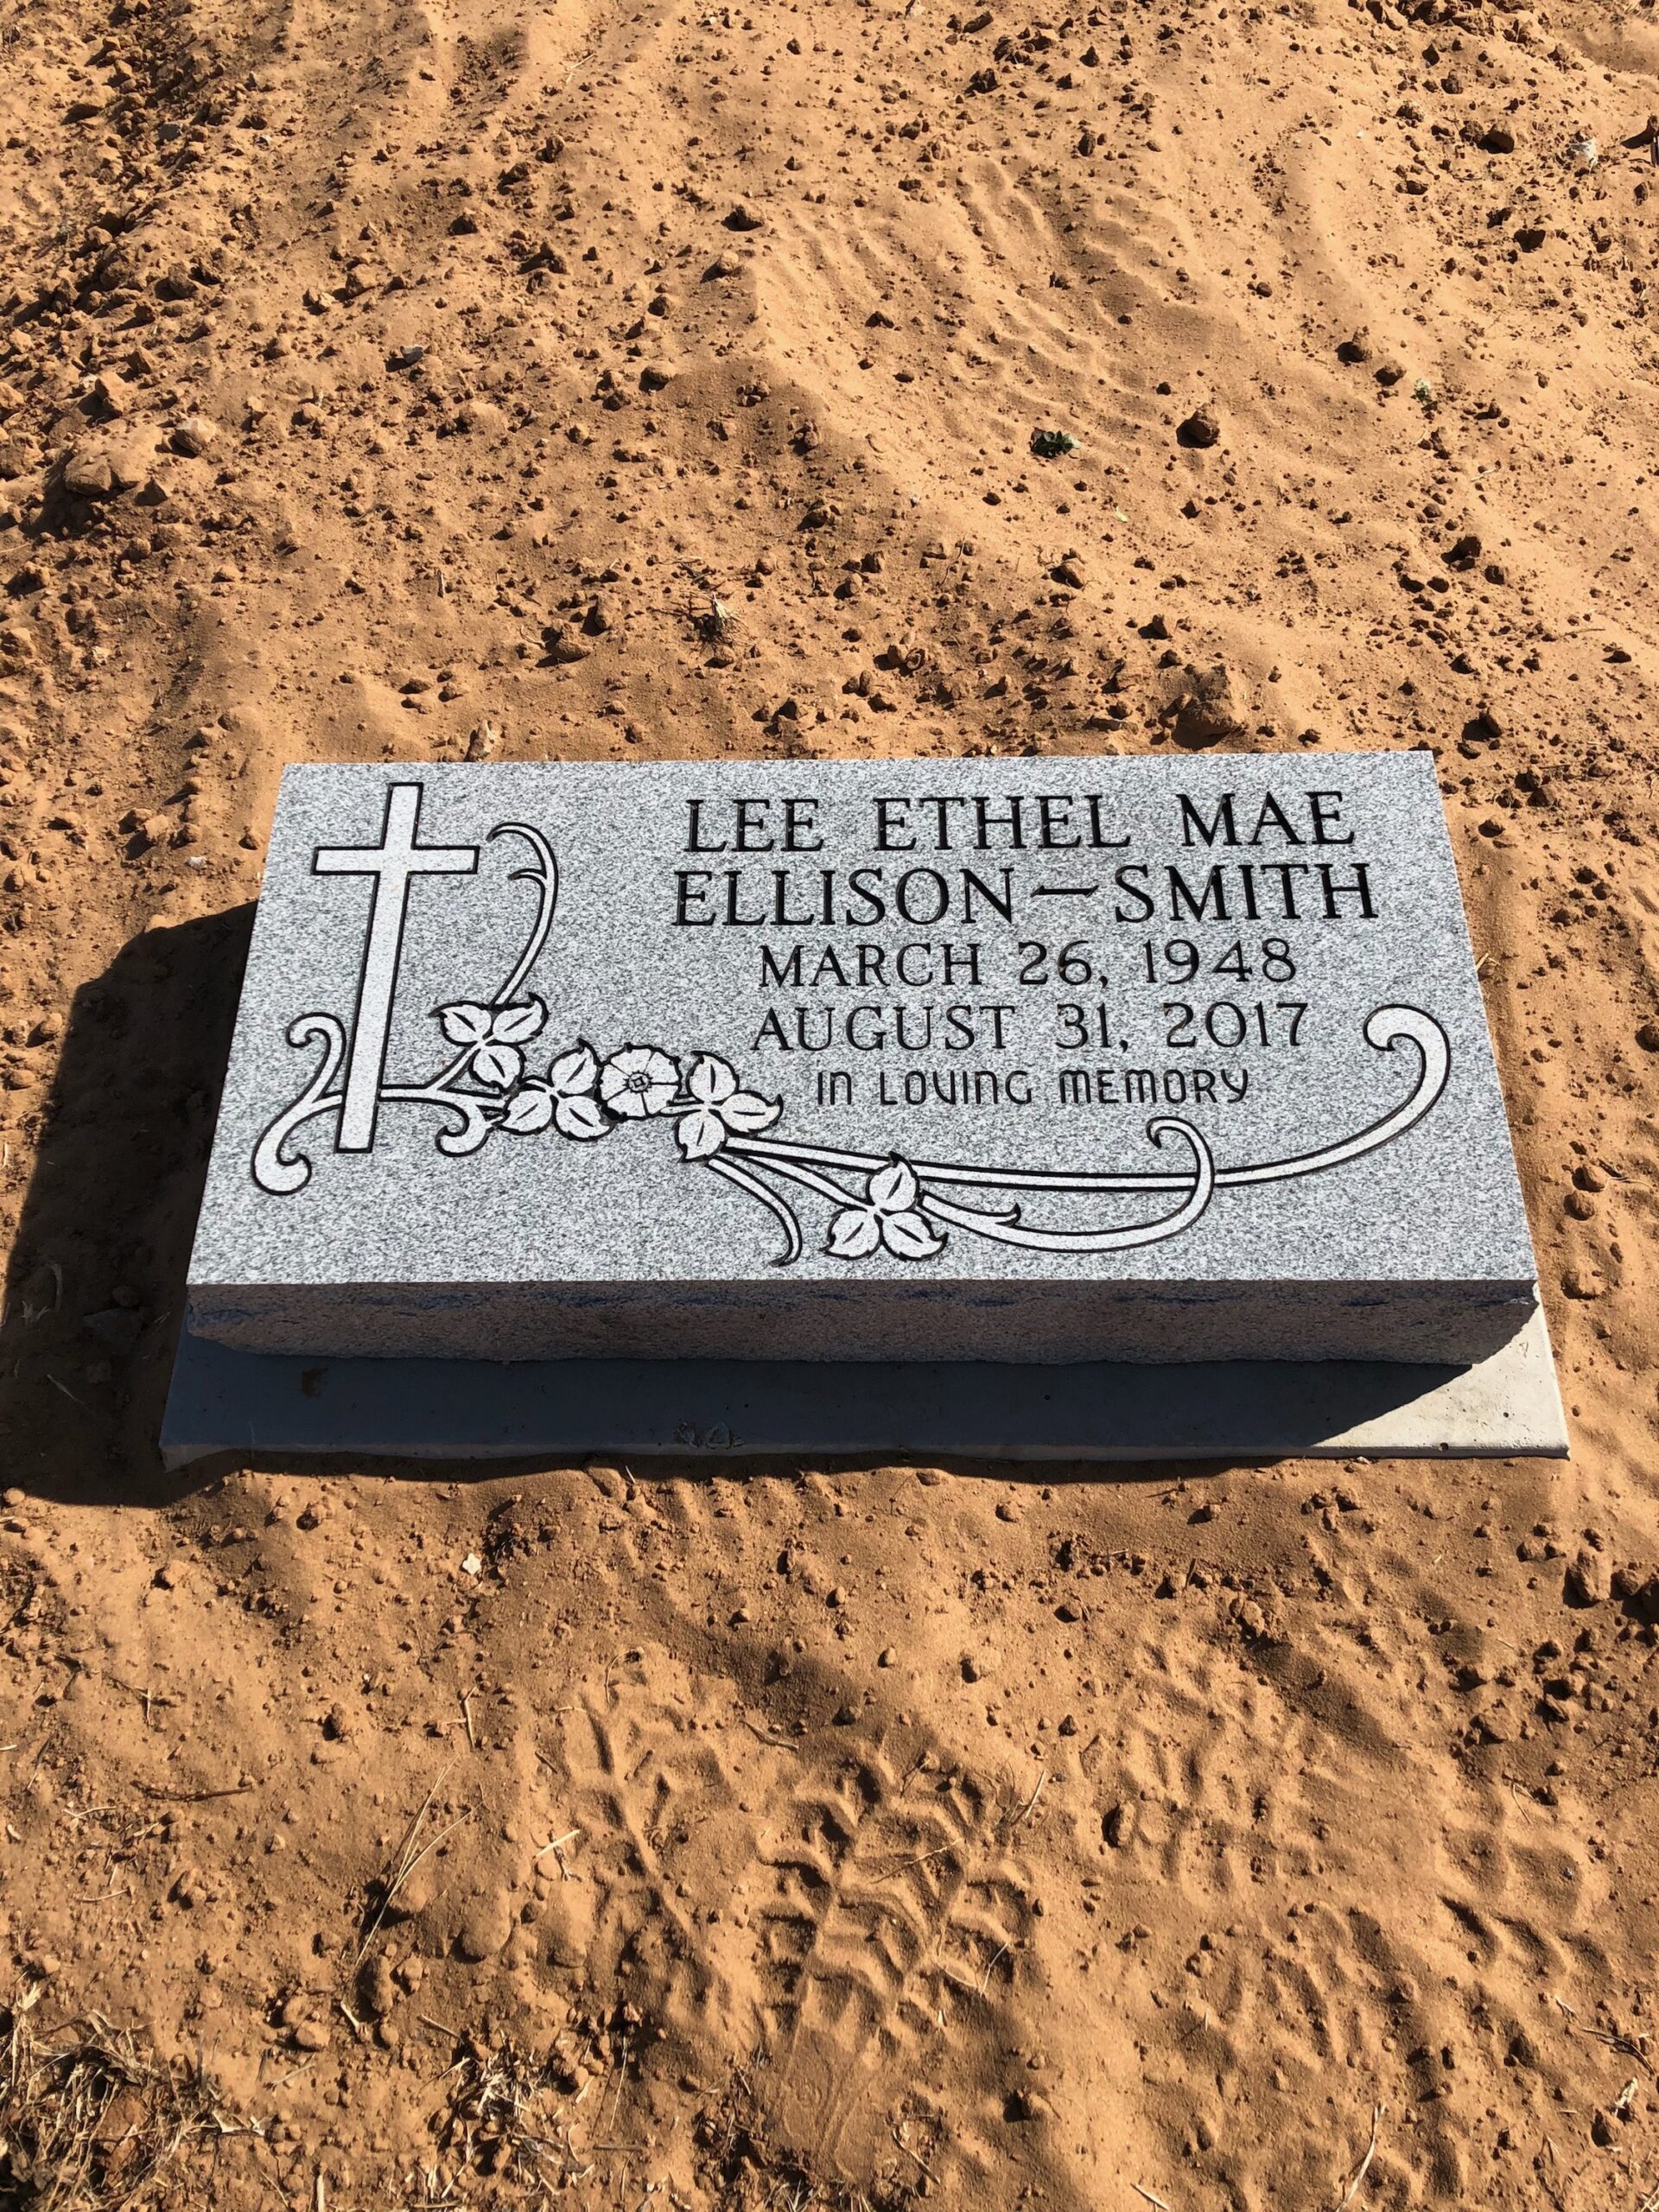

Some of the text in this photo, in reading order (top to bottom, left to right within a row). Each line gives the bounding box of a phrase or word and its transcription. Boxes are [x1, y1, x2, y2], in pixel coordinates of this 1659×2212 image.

[683, 791, 1355, 853] LEE ETHEL MAE
[760, 938, 1297, 988] MARCH 26, 1948
[750, 1001, 1308, 1052] AUGUST 31, 2017
